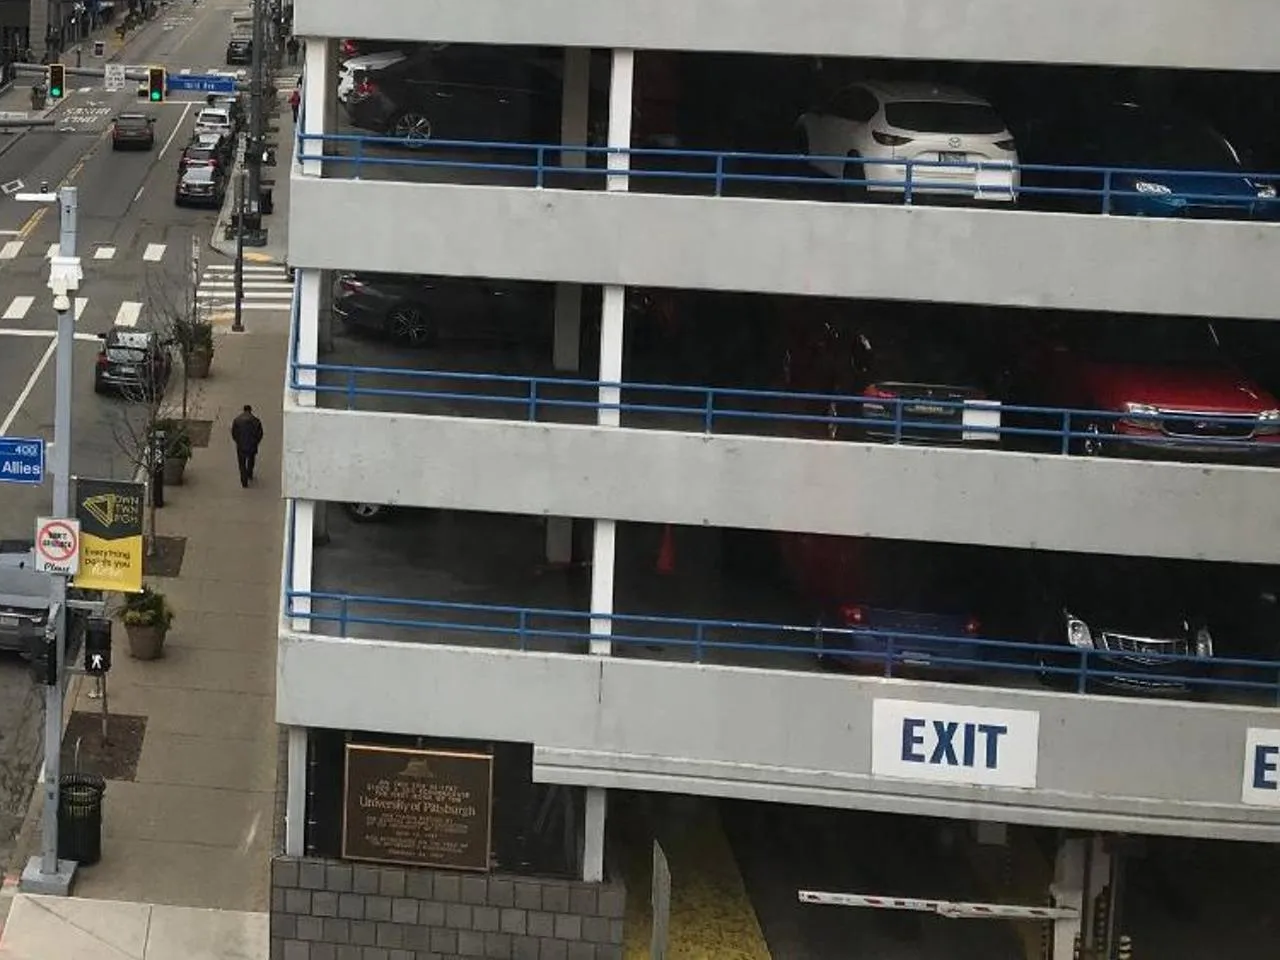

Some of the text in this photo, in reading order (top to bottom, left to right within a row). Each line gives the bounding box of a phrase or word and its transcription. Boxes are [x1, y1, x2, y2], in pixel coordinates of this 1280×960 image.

[2, 461, 40, 475] Allies
[85, 547, 131, 560] Everything
[901, 718, 1008, 769] EXIT
[359, 796, 409, 812] University
[423, 801, 476, 817] Pittsburgh
